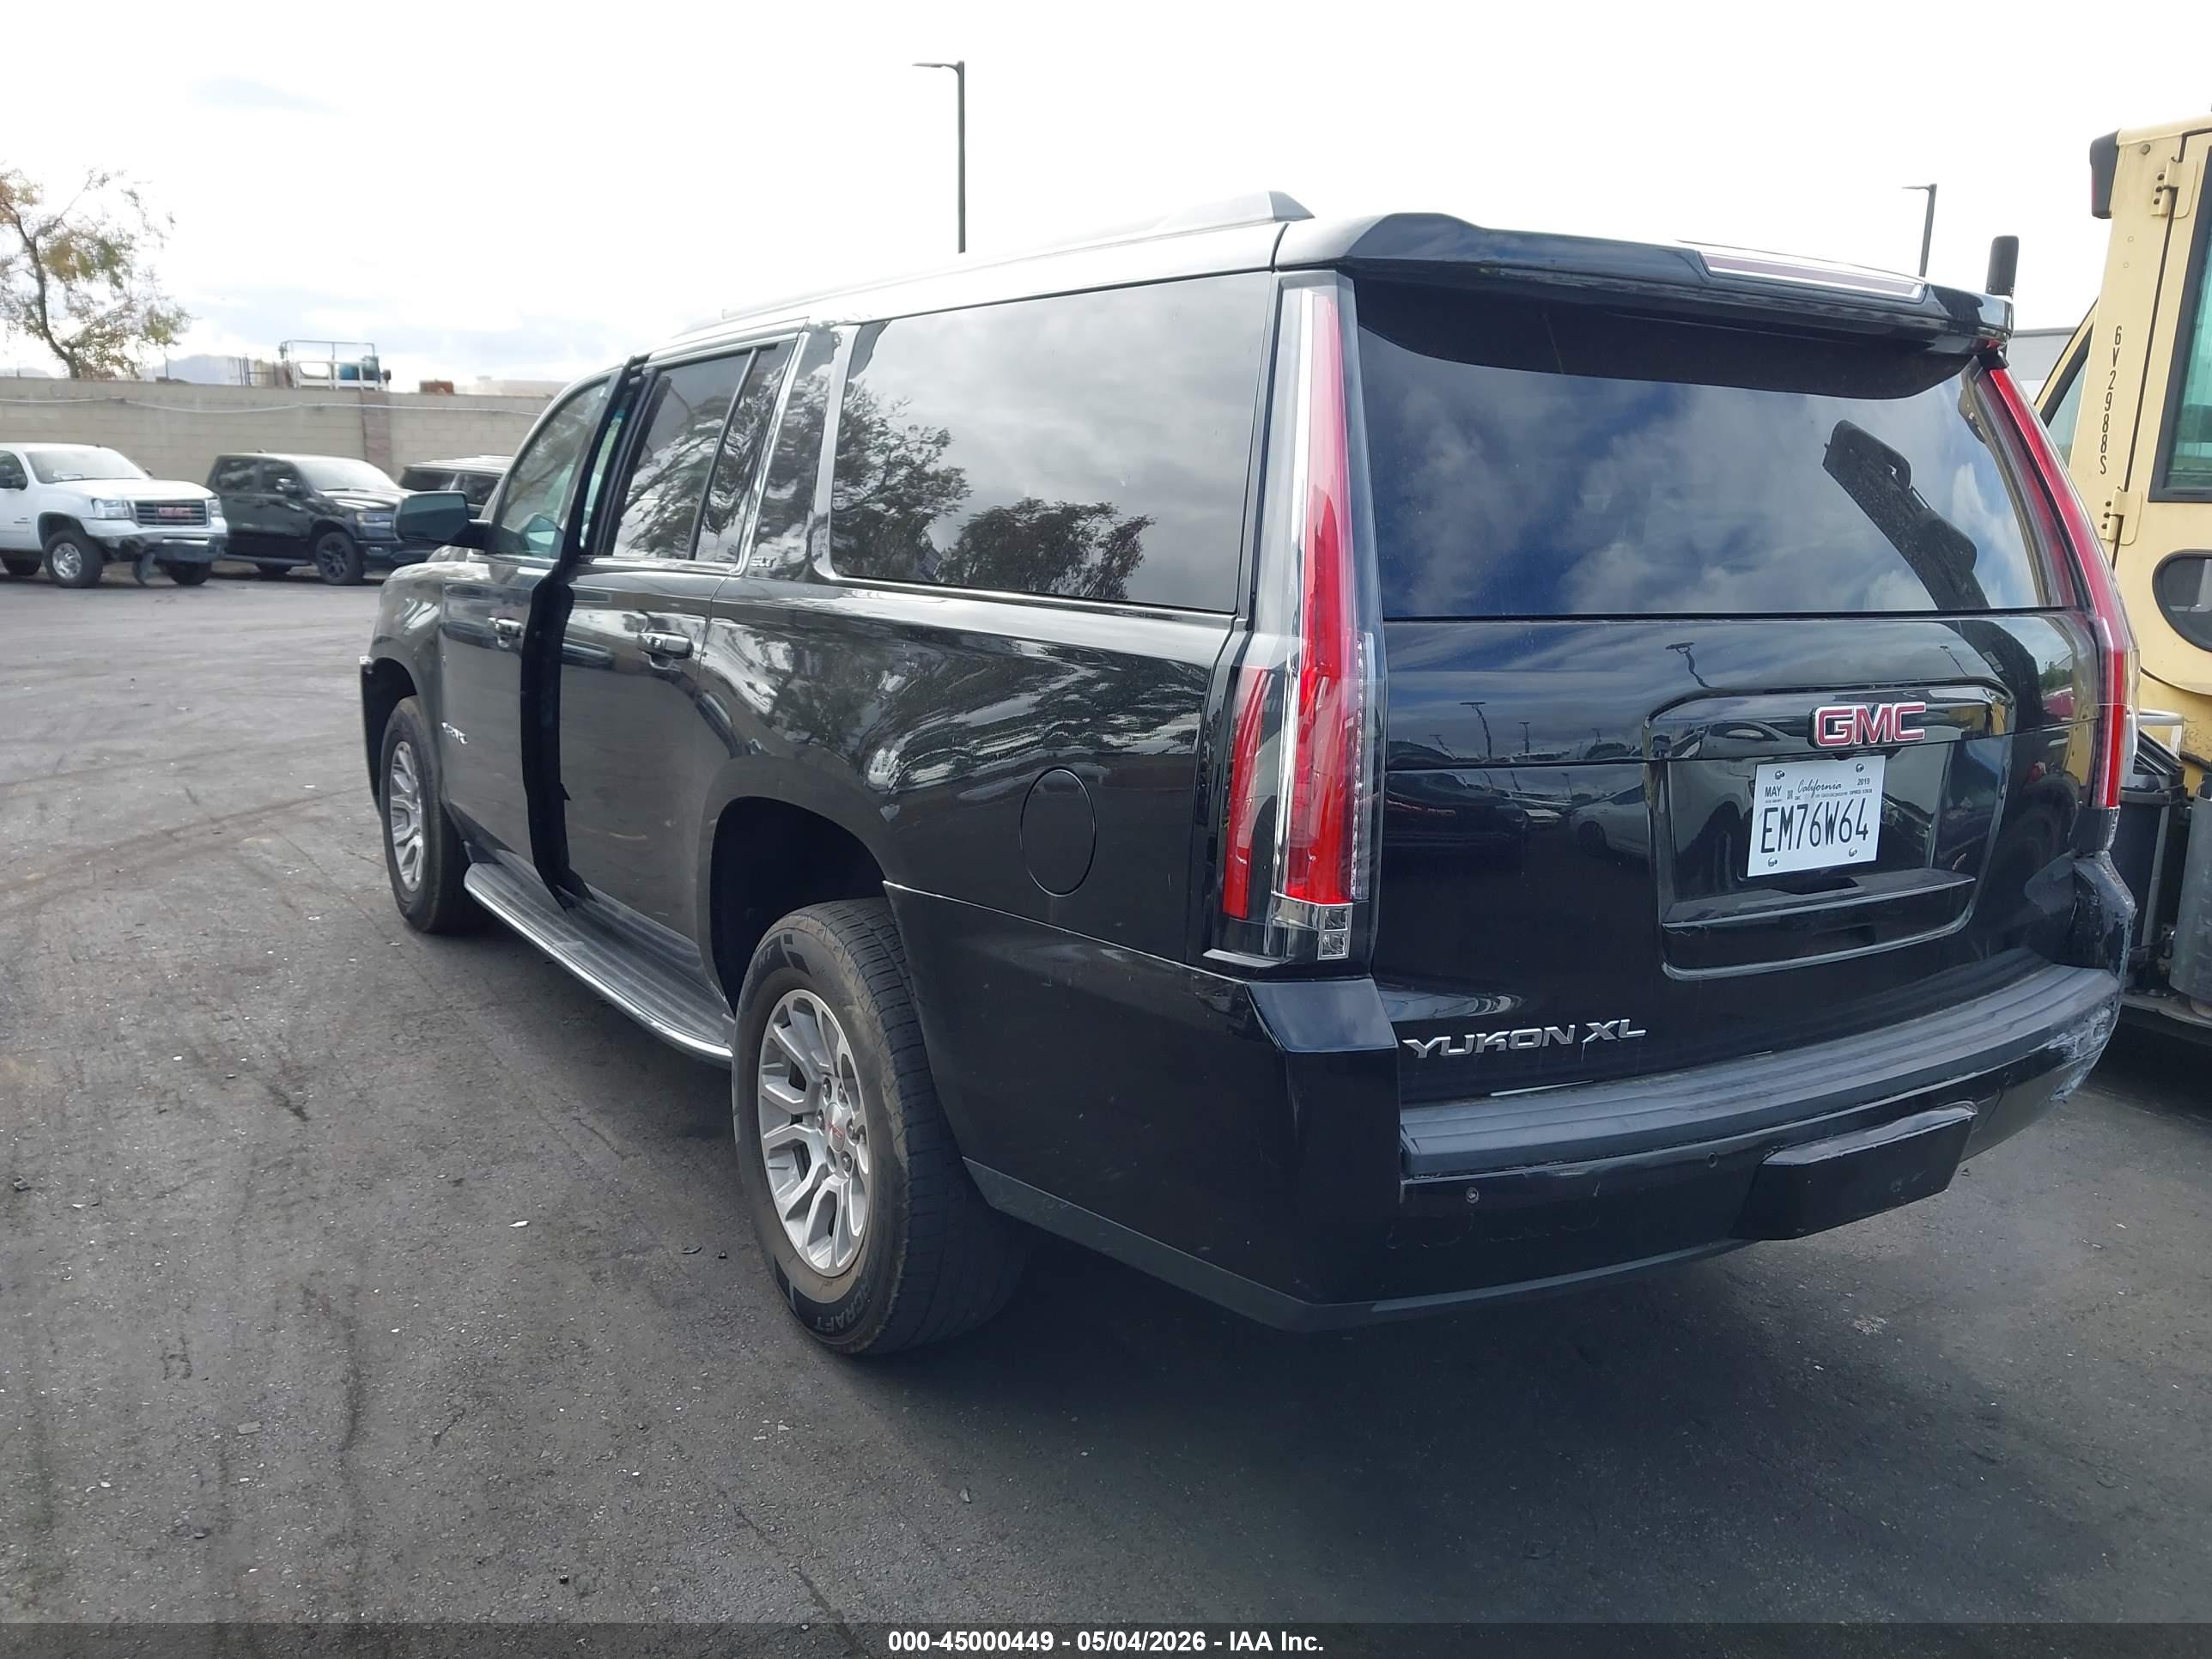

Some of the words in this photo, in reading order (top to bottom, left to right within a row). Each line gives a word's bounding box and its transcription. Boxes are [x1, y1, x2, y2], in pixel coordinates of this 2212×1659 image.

[2100, 325, 2123, 475] 6V2988S
[1814, 701, 1927, 746] GMC
[1765, 785, 1783, 798] MAY
[1797, 778, 1842, 799] California
[1760, 797, 1869, 854] EM76W64
[1401, 1024, 1577, 1059] YUKON
[1581, 1018, 1647, 1043] XL
